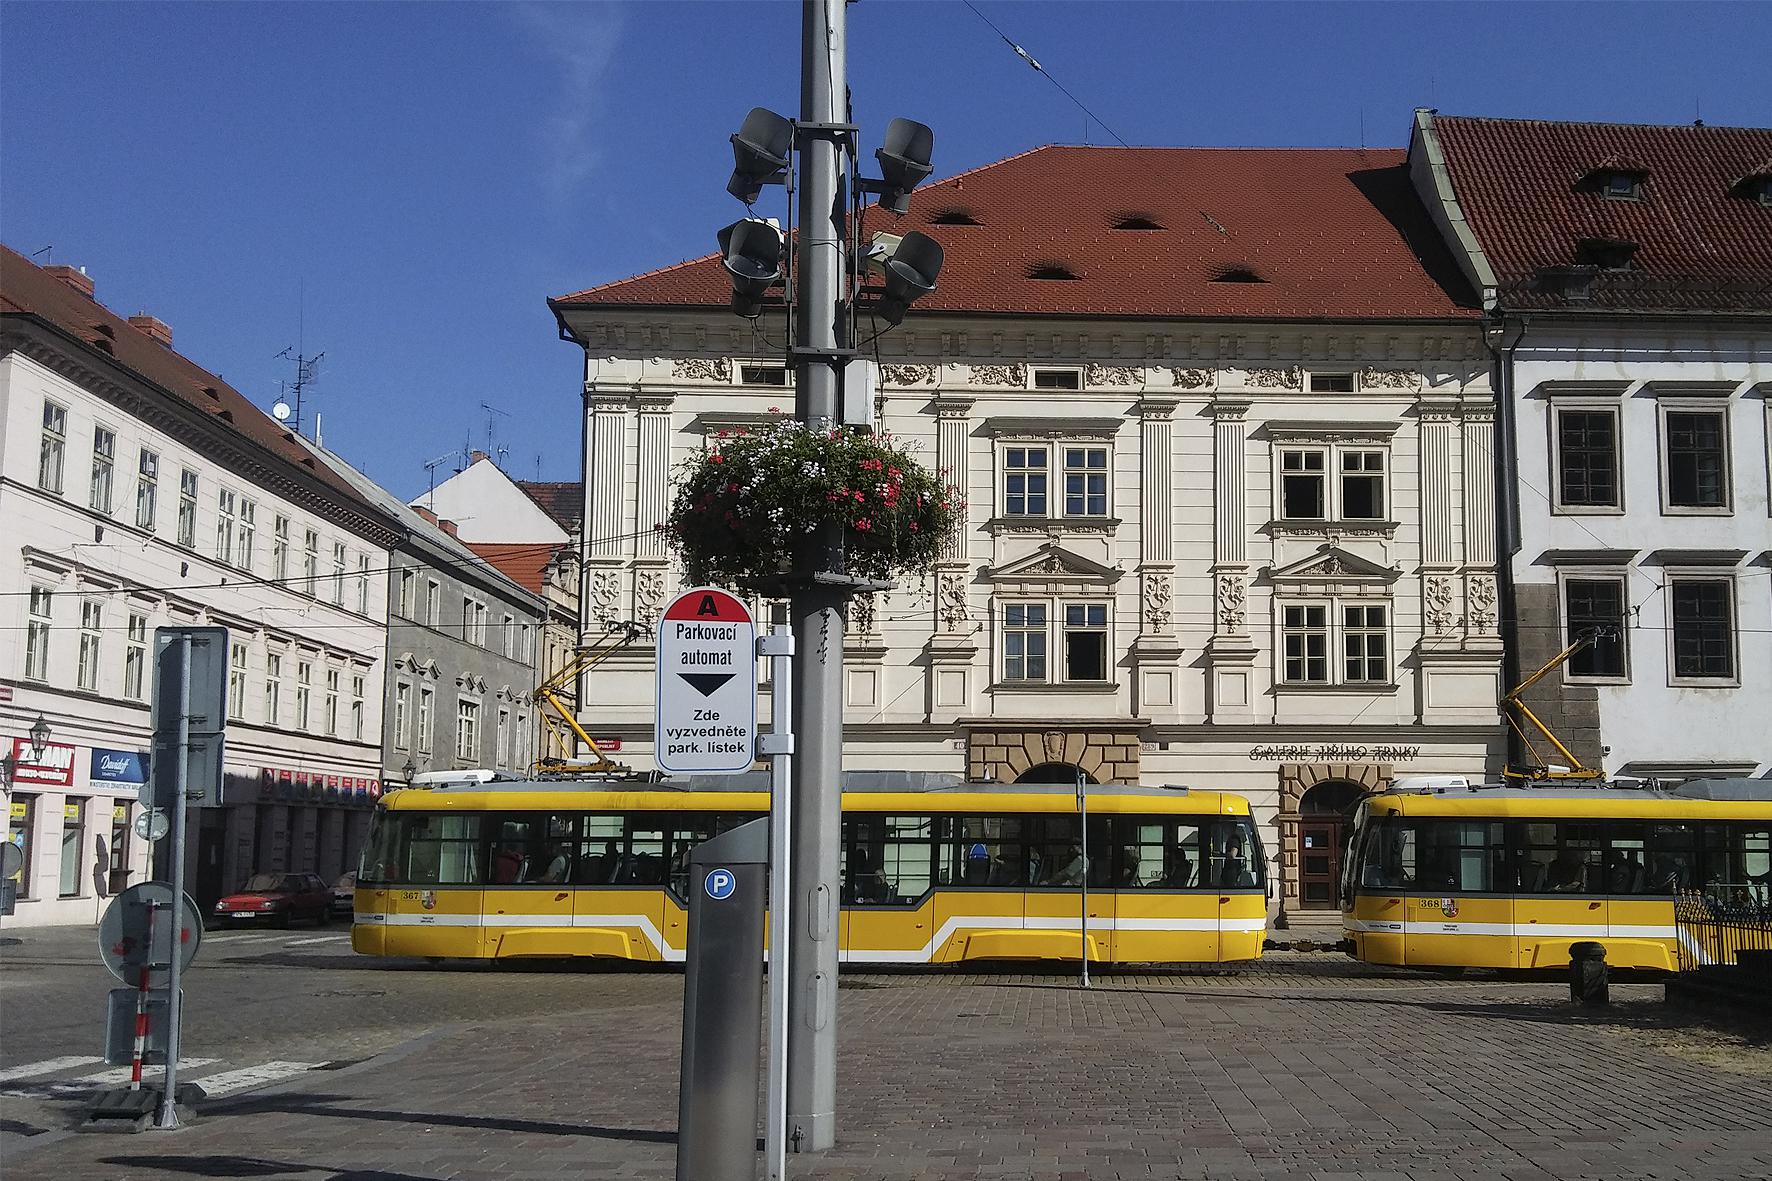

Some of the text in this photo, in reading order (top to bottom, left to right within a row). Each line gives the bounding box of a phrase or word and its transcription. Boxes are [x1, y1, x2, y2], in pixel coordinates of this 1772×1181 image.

[697, 595, 719, 616] A
[676, 623, 738, 641] Parkovací
[681, 649, 732, 665] automat
[693, 709, 720, 721] Zde
[666, 725, 746, 739] vyzvedněte
[668, 742, 745, 756] park. lístek
[1251, 743, 1420, 758] GALERIE JIŘÍHO TRNKY
[101, 754, 130, 774] Davidoff
[713, 875, 729, 893] P
[403, 892, 419, 900] 367
[1420, 899, 1440, 908] 368
